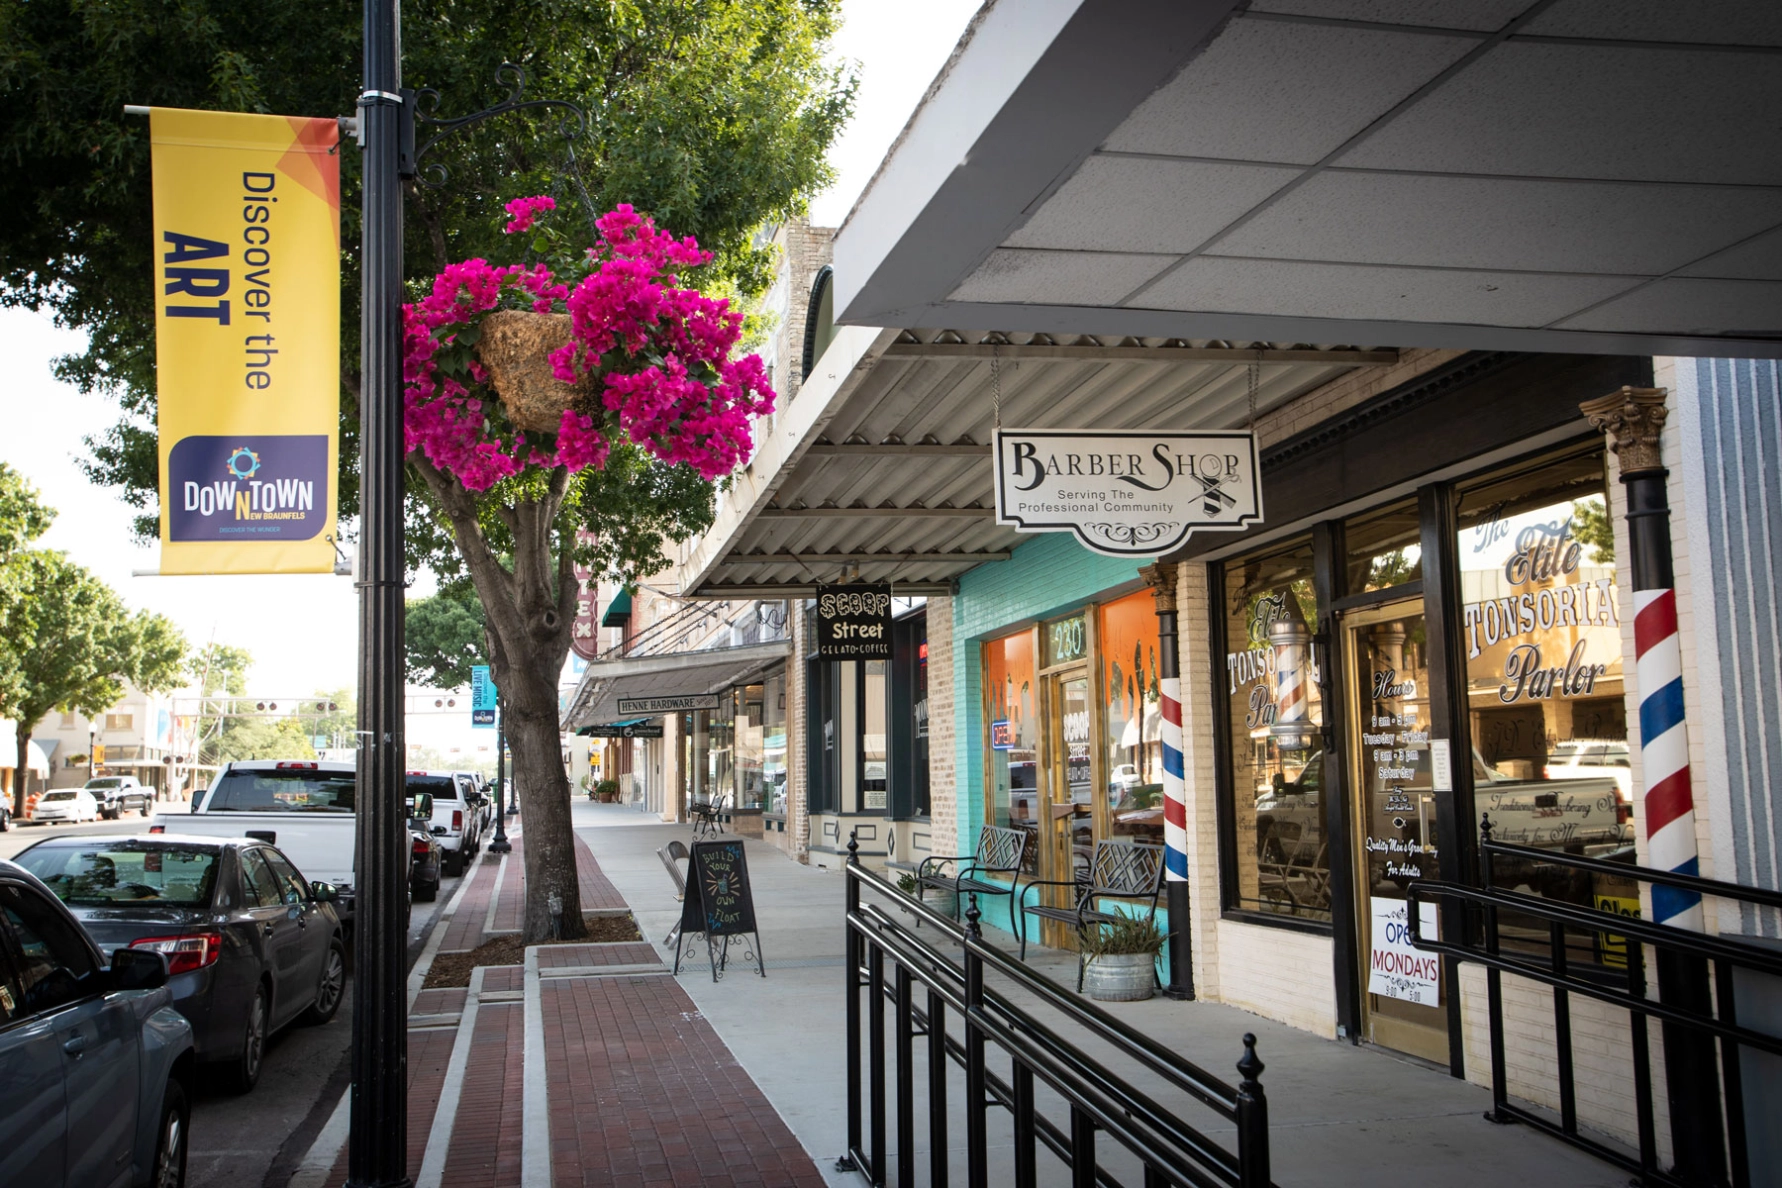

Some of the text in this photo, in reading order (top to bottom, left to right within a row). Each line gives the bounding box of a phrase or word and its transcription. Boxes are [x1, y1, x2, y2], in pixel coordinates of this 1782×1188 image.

[163, 231, 230, 326] ART
[242, 171, 279, 390] Discover the
[1057, 489, 1135, 501] Serving The
[263, 511, 306, 520] BRAUNFELS
[1018, 502, 1174, 514] Professional Community
[1473, 504, 1510, 554] The
[1505, 515, 1582, 587] Elite
[820, 592, 890, 619] SCOOP
[1464, 577, 1620, 661] TONSORIA
[832, 621, 884, 639] Street
[1055, 620, 1082, 660] 230
[1227, 643, 1321, 696] TONSOL
[1499, 637, 1607, 705] Parlor
[472, 670, 483, 707] LIVE MUSIC
[1371, 669, 1415, 699] Hours
[622, 700, 649, 712] HENNE
[650, 697, 696, 710] HARDWARE
[1378, 716, 1391, 727] am
[1404, 714, 1417, 728] pm
[994, 725, 1015, 745] OPE
[1363, 732, 1395, 746] Tuesday
[1401, 730, 1429, 745] Friday
[1380, 750, 1393, 762] am
[1405, 749, 1419, 763] pm
[1378, 766, 1416, 780] Saturday
[702, 850, 735, 864] BUILD
[1366, 836, 1439, 859] Quality Men's Groong
[709, 862, 731, 873] YOUR
[1386, 860, 1421, 878] For Adults
[716, 896, 735, 907] OWN
[714, 908, 741, 924] FLOAT
[1385, 922, 1413, 946] OPE
[1372, 948, 1437, 982] MONDAYS
